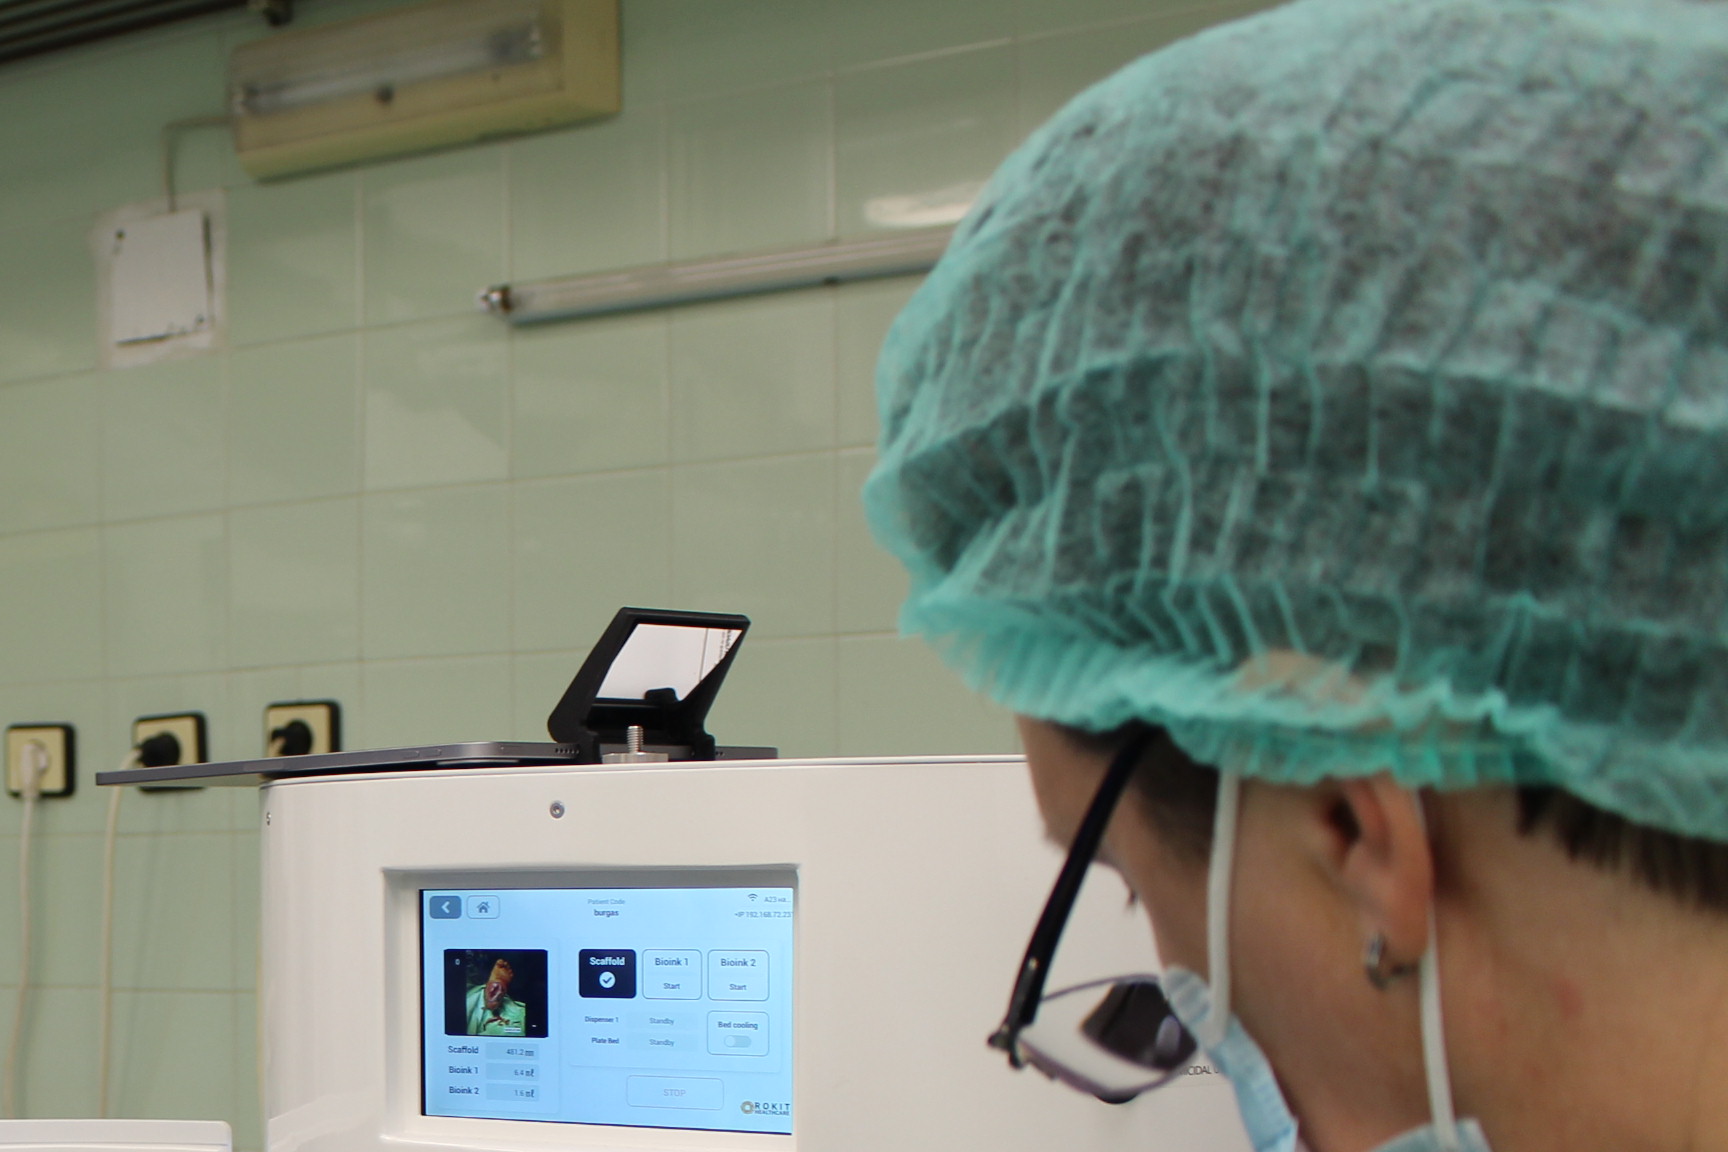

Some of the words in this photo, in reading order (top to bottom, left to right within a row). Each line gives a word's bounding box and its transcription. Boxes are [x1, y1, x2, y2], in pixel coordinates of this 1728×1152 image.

[594, 909, 619, 918] burgas
[589, 957, 626, 966] Scaffold
[655, 957, 682, 966] Bioink
[684, 958, 689, 966] 1
[721, 958, 748, 967] Bioink
[750, 959, 756, 967] 2
[729, 983, 747, 991] Start
[649, 1017, 674, 1025] Standby
[732, 1022, 758, 1030] cooling
[649, 1039, 674, 1047] Standby
[448, 1045, 479, 1054] Scaffold
[448, 1066, 472, 1074] Bioink
[449, 1086, 472, 1094] Bioink
[663, 1089, 686, 1097] STOP
[754, 1102, 790, 1111] ROKIT
